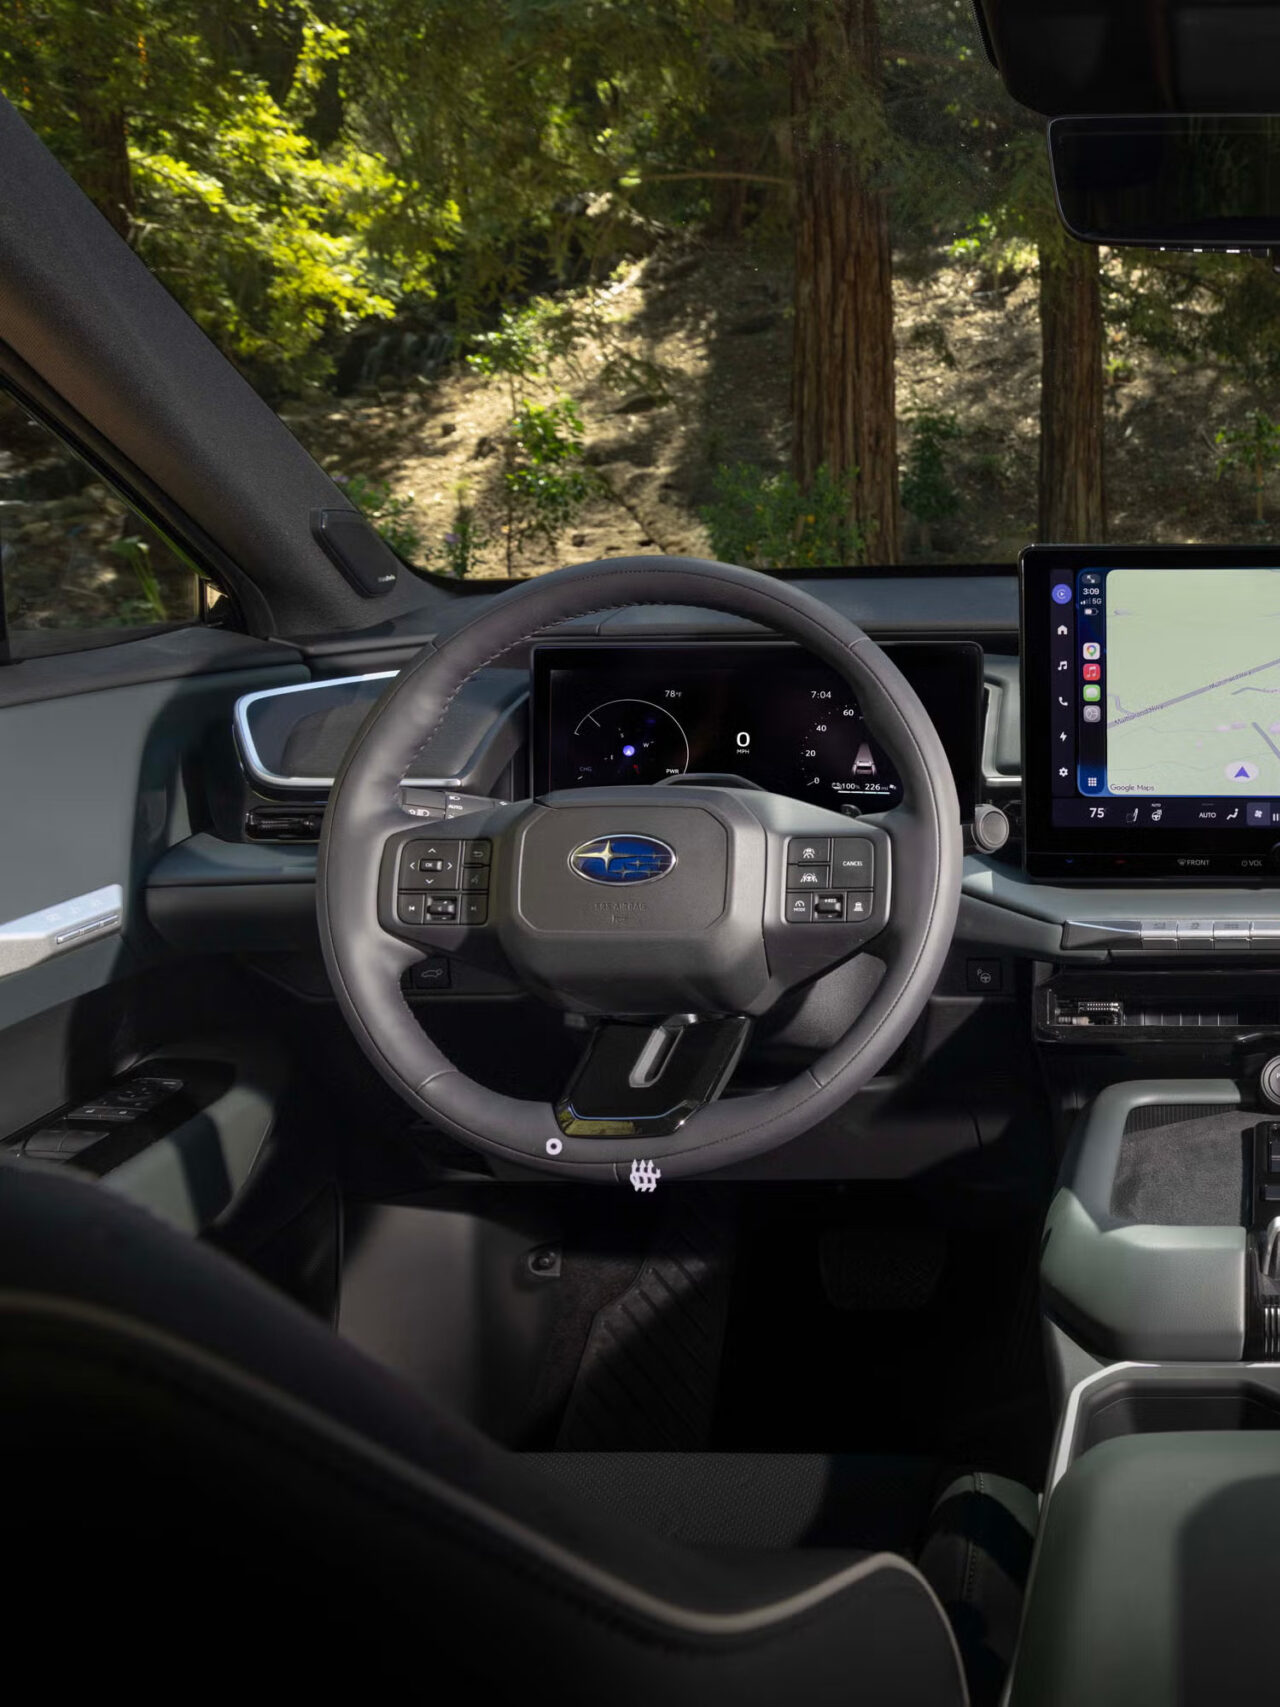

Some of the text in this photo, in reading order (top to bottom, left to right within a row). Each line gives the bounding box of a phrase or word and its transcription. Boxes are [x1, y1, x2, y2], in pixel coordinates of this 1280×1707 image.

[811, 691, 831, 699] 7:04
[736, 732, 750, 747] 0
[865, 783, 880, 791] 226
[1110, 784, 1155, 792] Google Maps
[1199, 811, 1217, 819] AUTO
